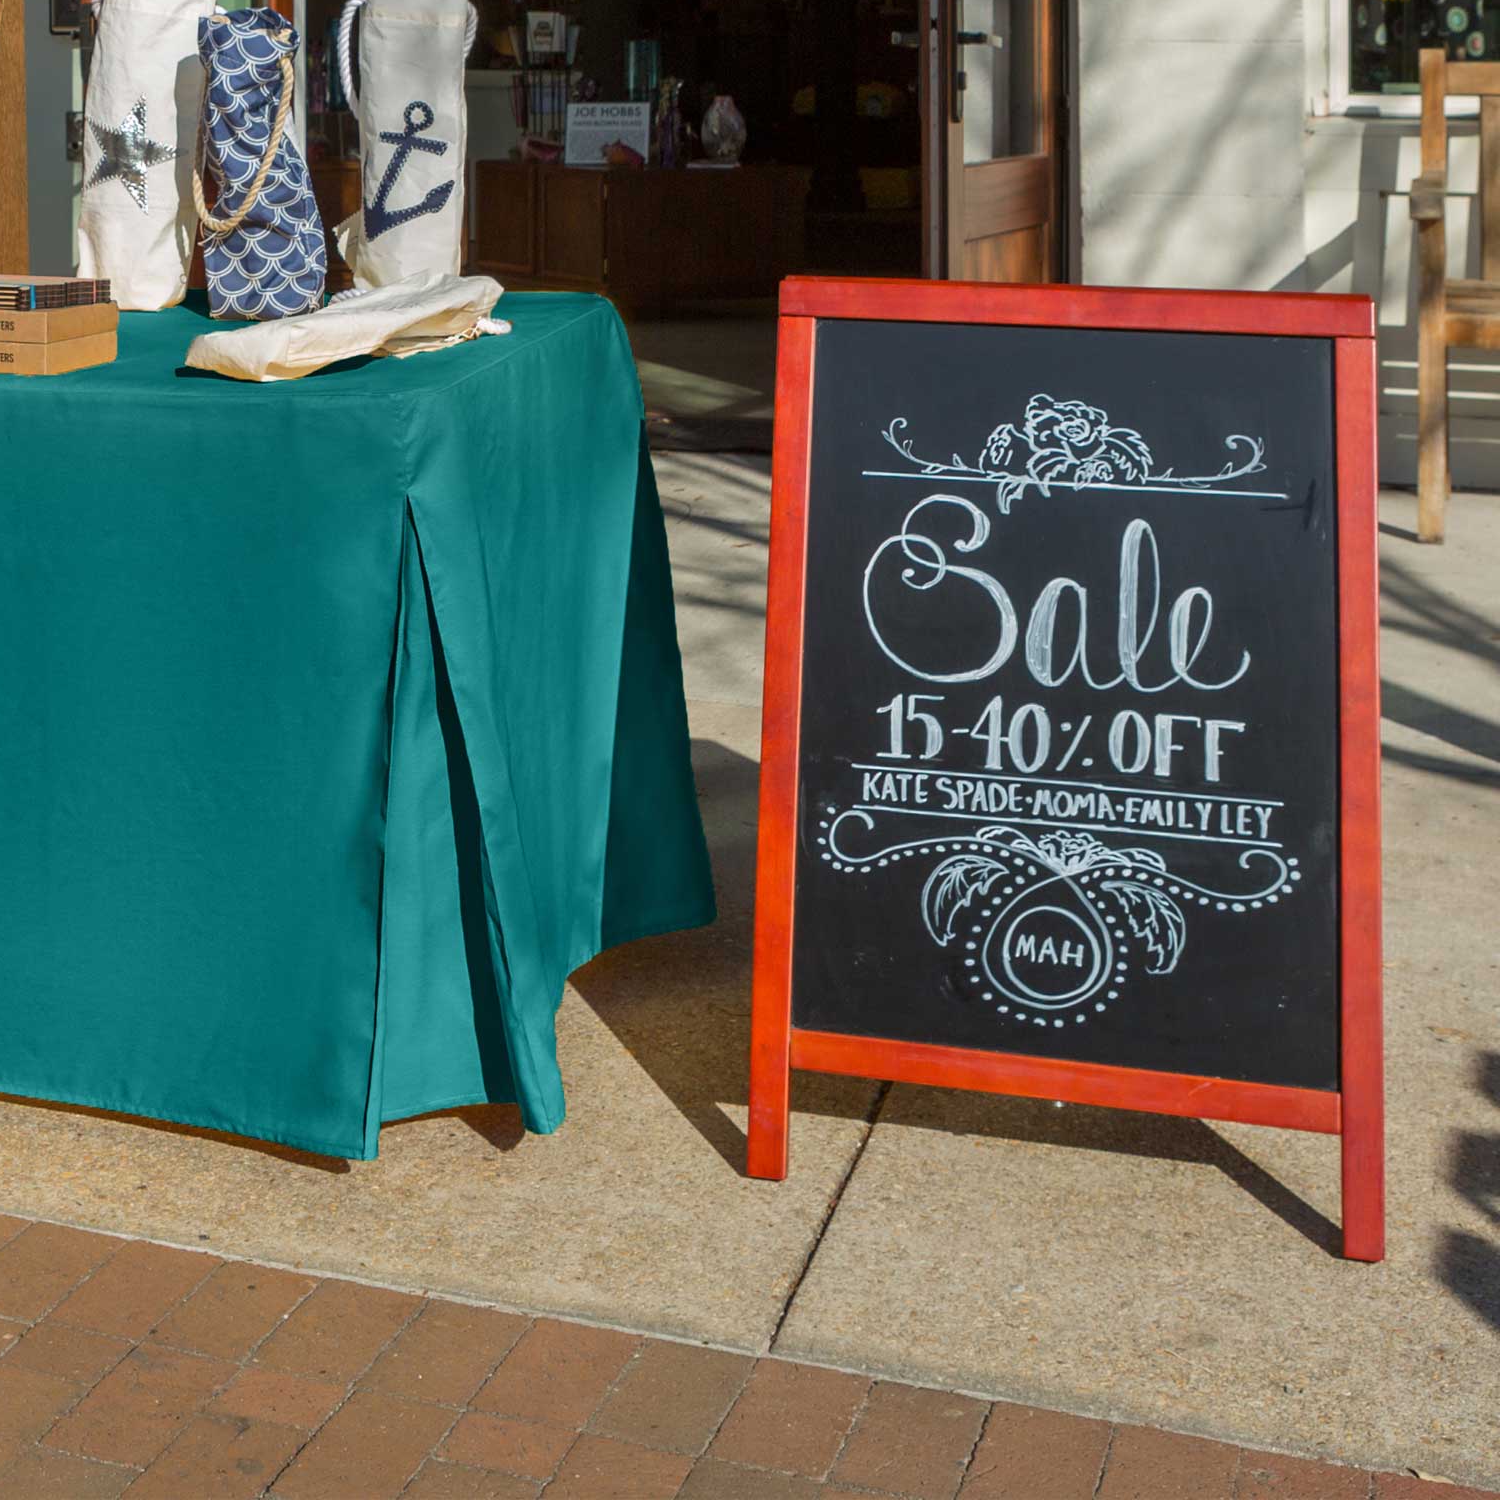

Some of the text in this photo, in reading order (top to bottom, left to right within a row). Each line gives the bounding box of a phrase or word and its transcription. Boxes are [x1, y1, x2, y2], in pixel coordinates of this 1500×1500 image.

[574, 106, 642, 117] JOE HOBBS
[863, 494, 1251, 692] Sale
[876, 694, 1246, 782] 15-40% OFF
[862, 772, 928, 804] KATE
[1220, 803, 1272, 839] LEY
[1015, 934, 1084, 968] MAH
